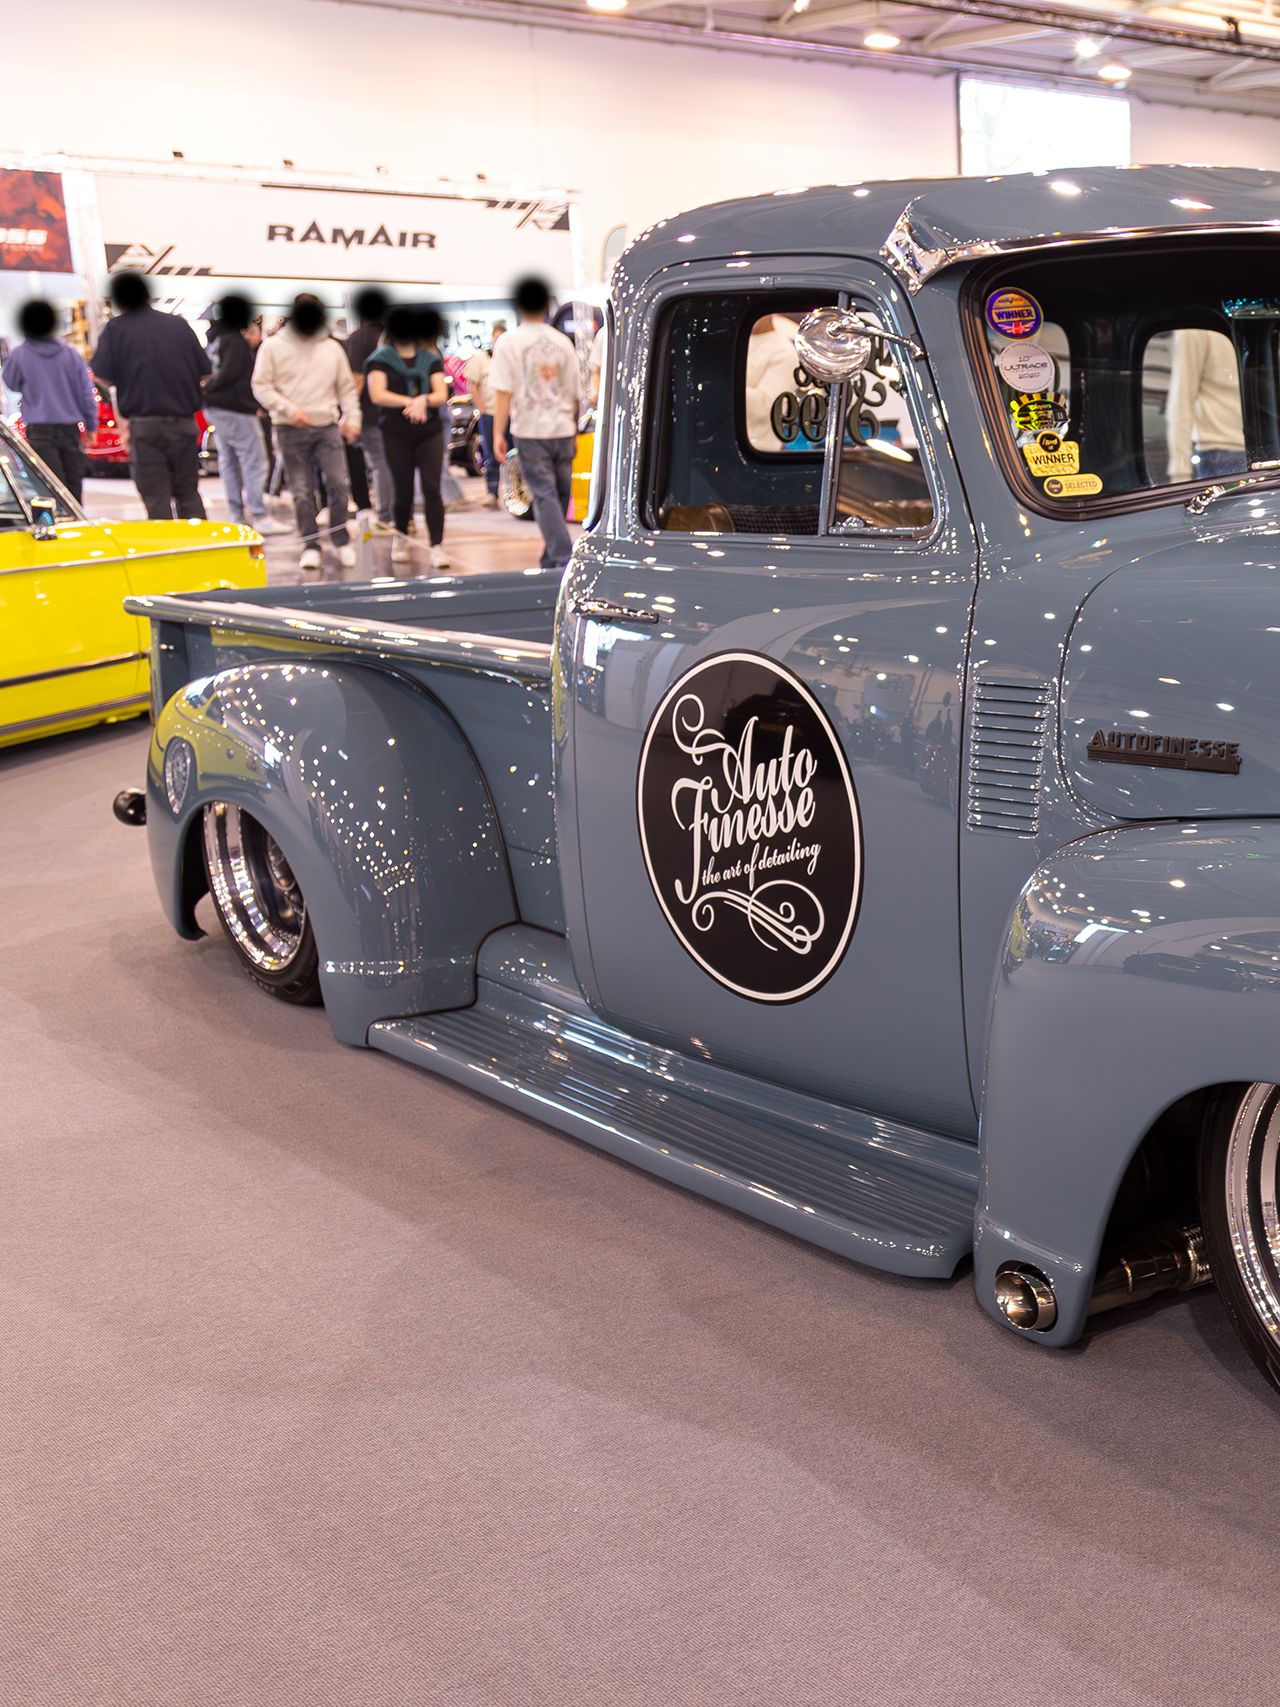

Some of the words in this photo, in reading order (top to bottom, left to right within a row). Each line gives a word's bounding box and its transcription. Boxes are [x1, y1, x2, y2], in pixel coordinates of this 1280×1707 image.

[267, 219, 437, 250] RAMAIR
[995, 309, 1034, 320] WINNER
[1004, 362, 1048, 371] ULTRACE
[1032, 453, 1075, 465] WINNER
[1064, 481, 1098, 489] SELECTED
[671, 776, 816, 904] Finesse
[701, 856, 721, 886] the
[722, 860, 742, 880] art
[743, 842, 760, 891] of
[757, 837, 821, 875] detailing
